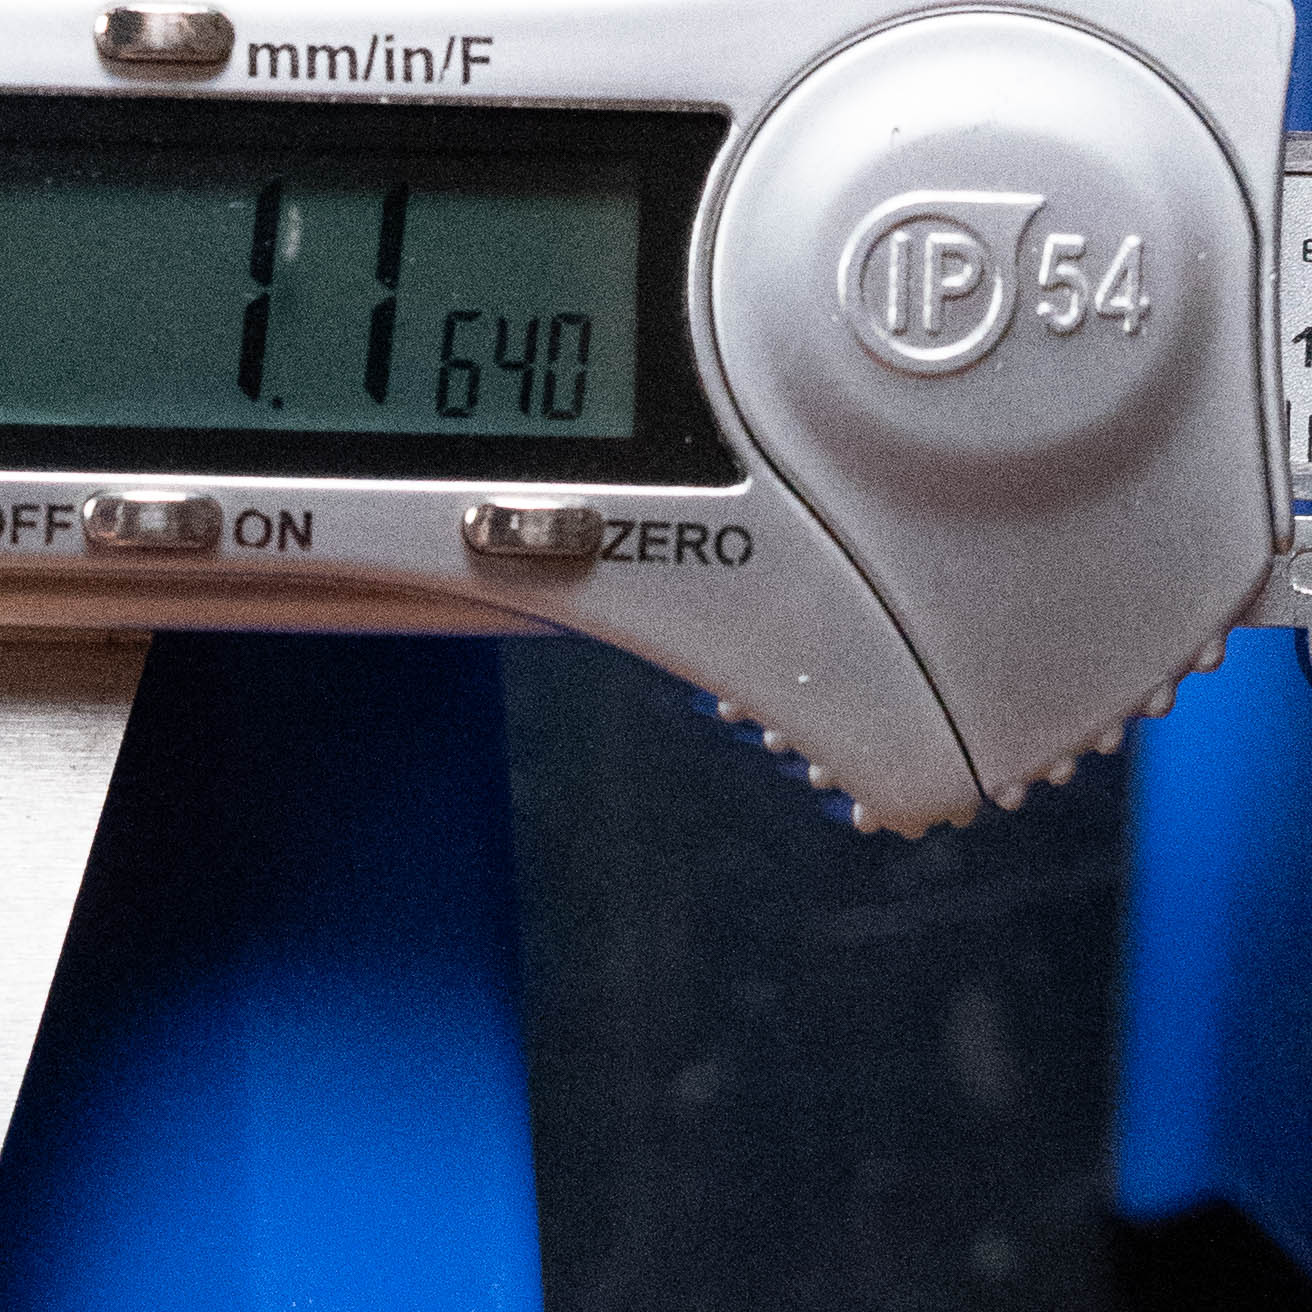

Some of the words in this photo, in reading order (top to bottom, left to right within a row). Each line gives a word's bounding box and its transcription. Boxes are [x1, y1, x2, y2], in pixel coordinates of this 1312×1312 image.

[248, 34, 494, 86] mm/in/F
[237, 178, 593, 420] 1.1640
[1036, 231, 1152, 337] 54
[233, 508, 314, 553] ON
[601, 519, 755, 568] ZERO
